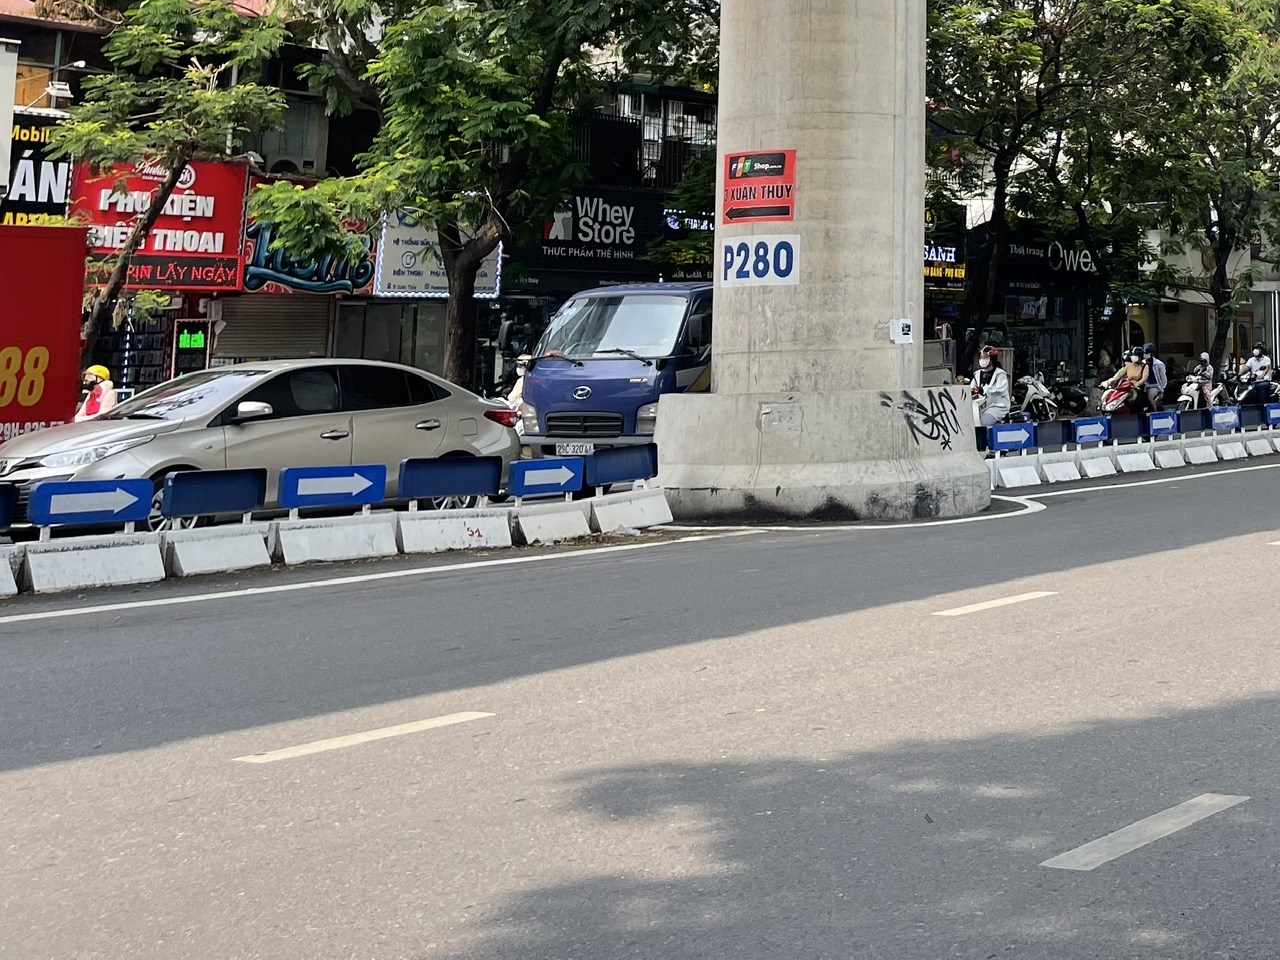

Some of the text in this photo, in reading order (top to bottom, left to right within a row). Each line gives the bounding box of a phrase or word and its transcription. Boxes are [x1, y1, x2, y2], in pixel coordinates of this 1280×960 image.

[12, 124, 51, 143] Mobil
[576, 196, 634, 230] Whey
[578, 217, 635, 244] Store
[543, 246, 566, 258] THỰC
[724, 241, 793, 280] P280
[1048, 240, 1097, 272] Owe
